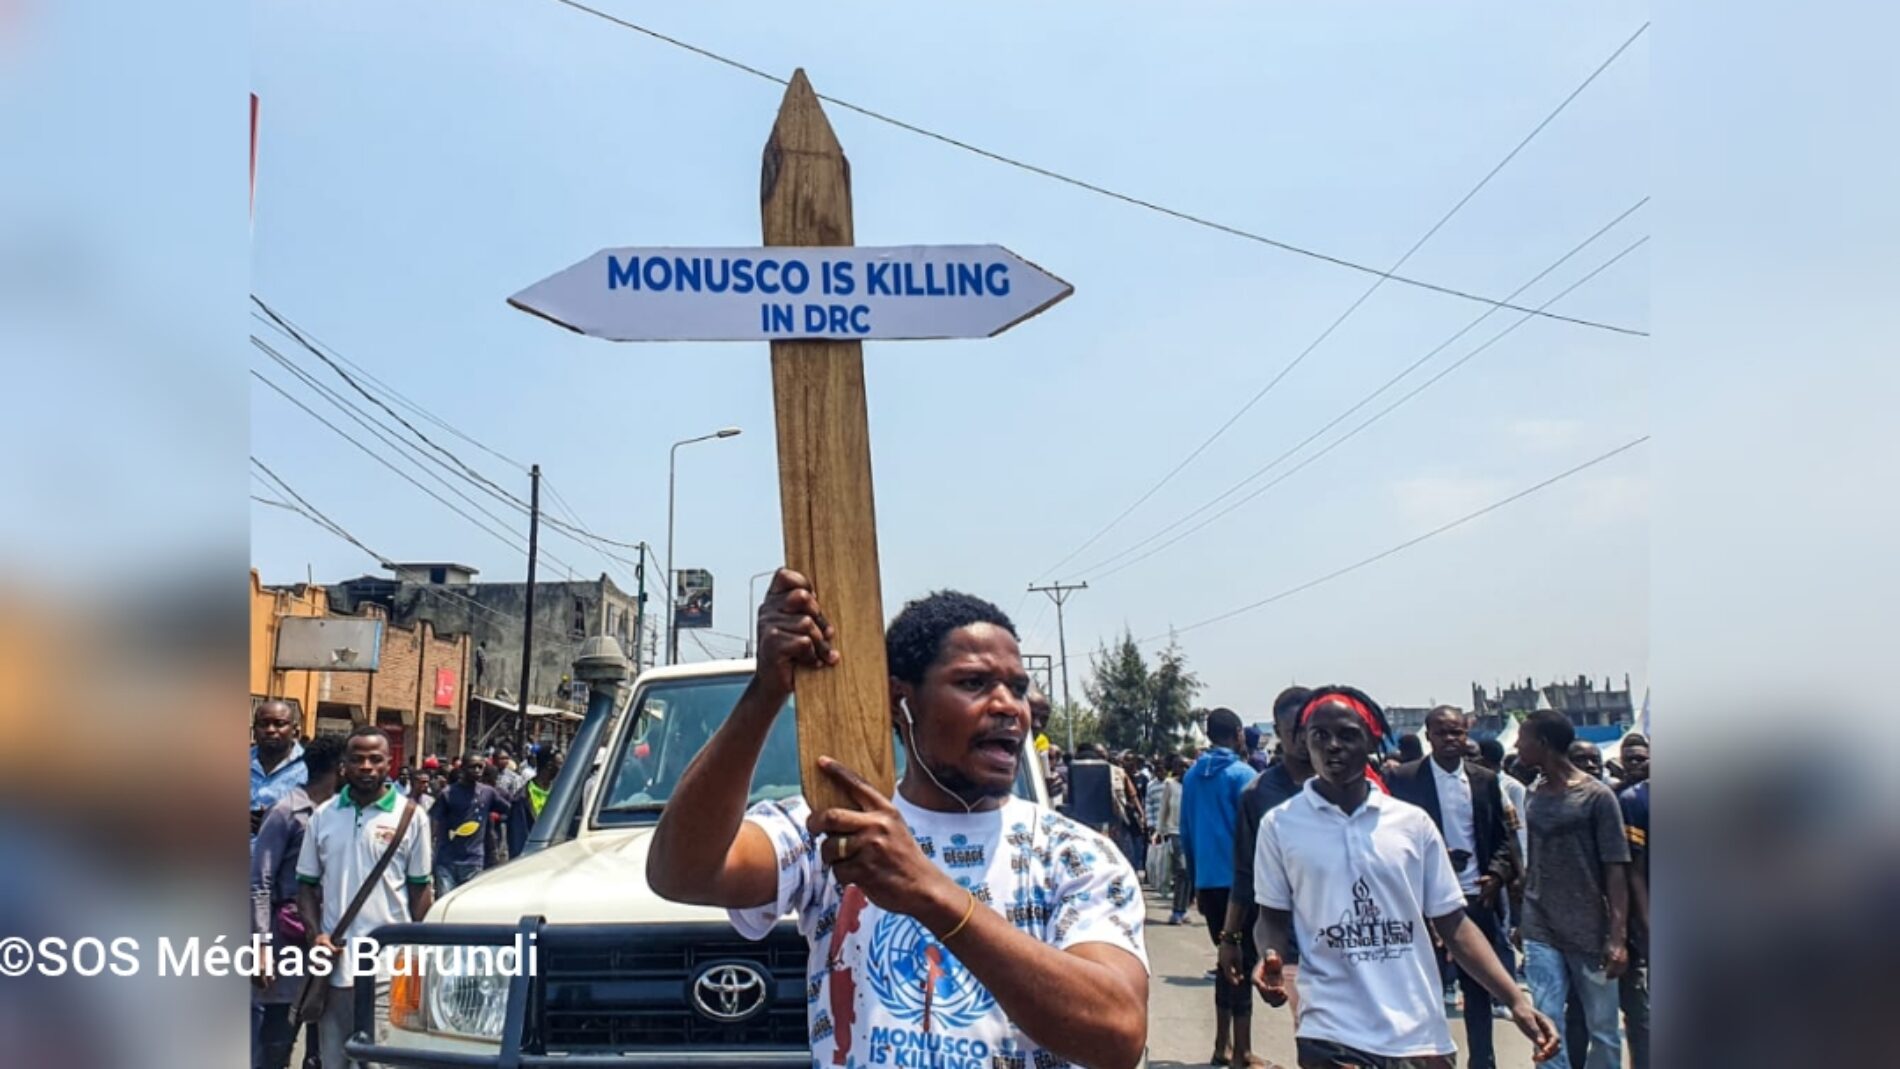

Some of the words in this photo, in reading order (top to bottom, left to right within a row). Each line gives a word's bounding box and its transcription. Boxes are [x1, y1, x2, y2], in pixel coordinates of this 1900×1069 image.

[607, 255, 811, 295] MONUSCO
[822, 261, 855, 296] IS
[866, 261, 1011, 297] KILLING
[762, 304, 795, 333] IN
[804, 304, 872, 334] DRC
[869, 1044, 887, 1064] IS
[894, 1047, 983, 1069] KILLING
[870, 1026, 989, 1059] MONUSCO
